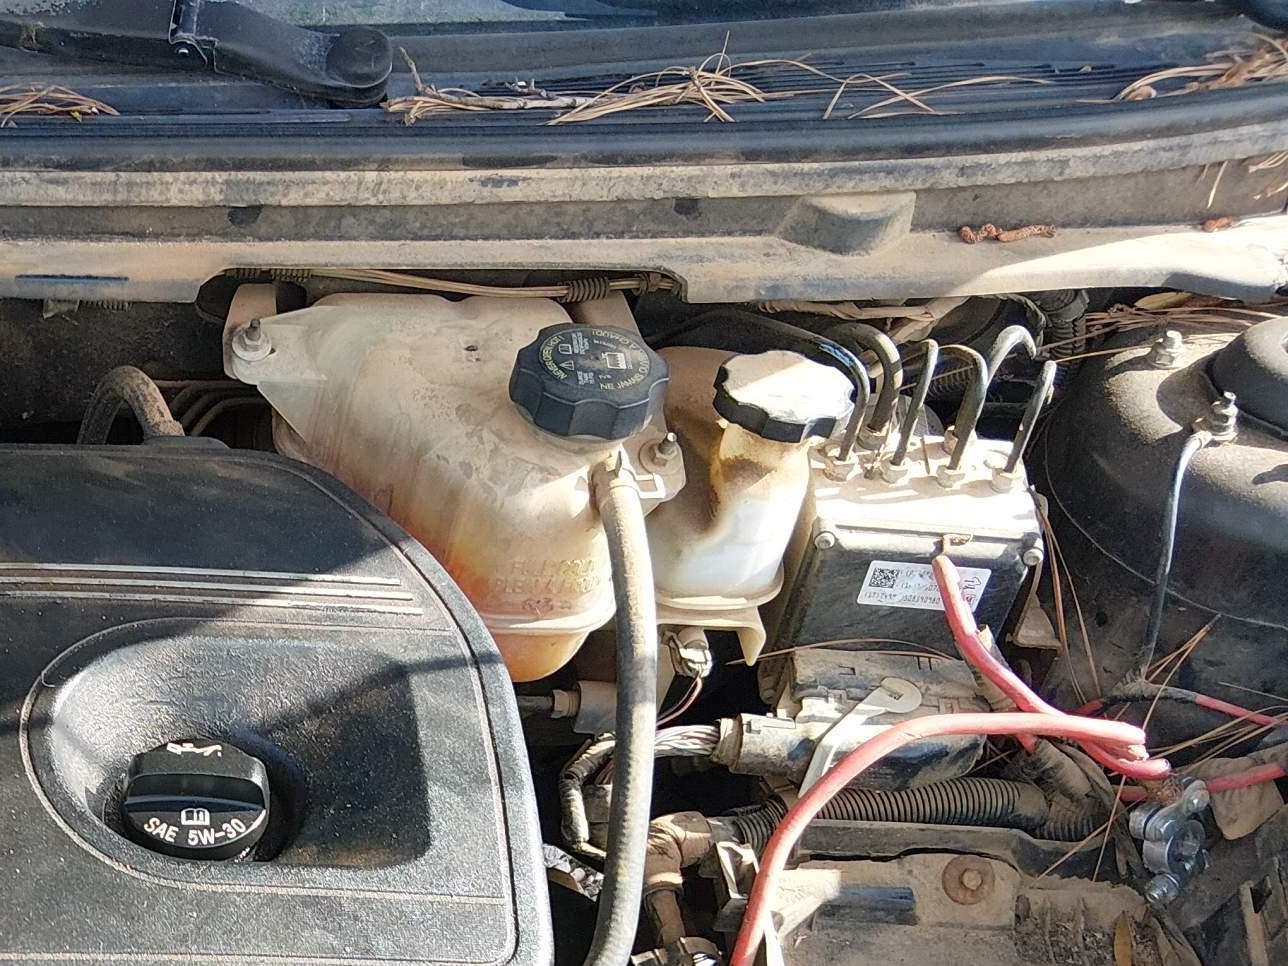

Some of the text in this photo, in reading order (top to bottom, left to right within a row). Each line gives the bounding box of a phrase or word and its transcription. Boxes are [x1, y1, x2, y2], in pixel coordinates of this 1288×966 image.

[544, 361, 568, 380] NEVER
[143, 817, 246, 846] SAE 5W-30
